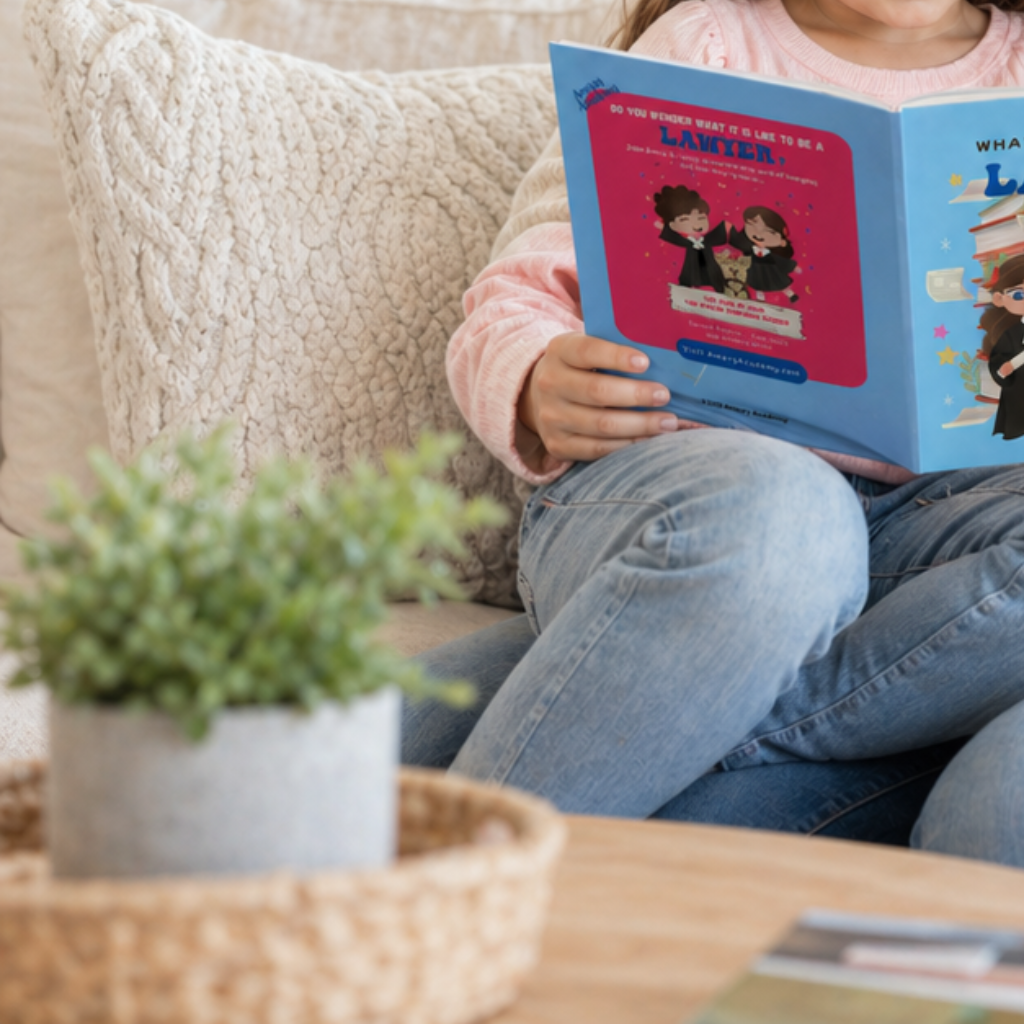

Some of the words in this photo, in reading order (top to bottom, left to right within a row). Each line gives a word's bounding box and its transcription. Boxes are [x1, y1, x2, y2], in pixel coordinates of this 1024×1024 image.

[610, 104, 623, 114] DO
[627, 106, 647, 118] YOU
[695, 118, 725, 133] WHAT
[779, 134, 793, 146] TO
[797, 137, 811, 150] BE
[815, 141, 824, 151] A
